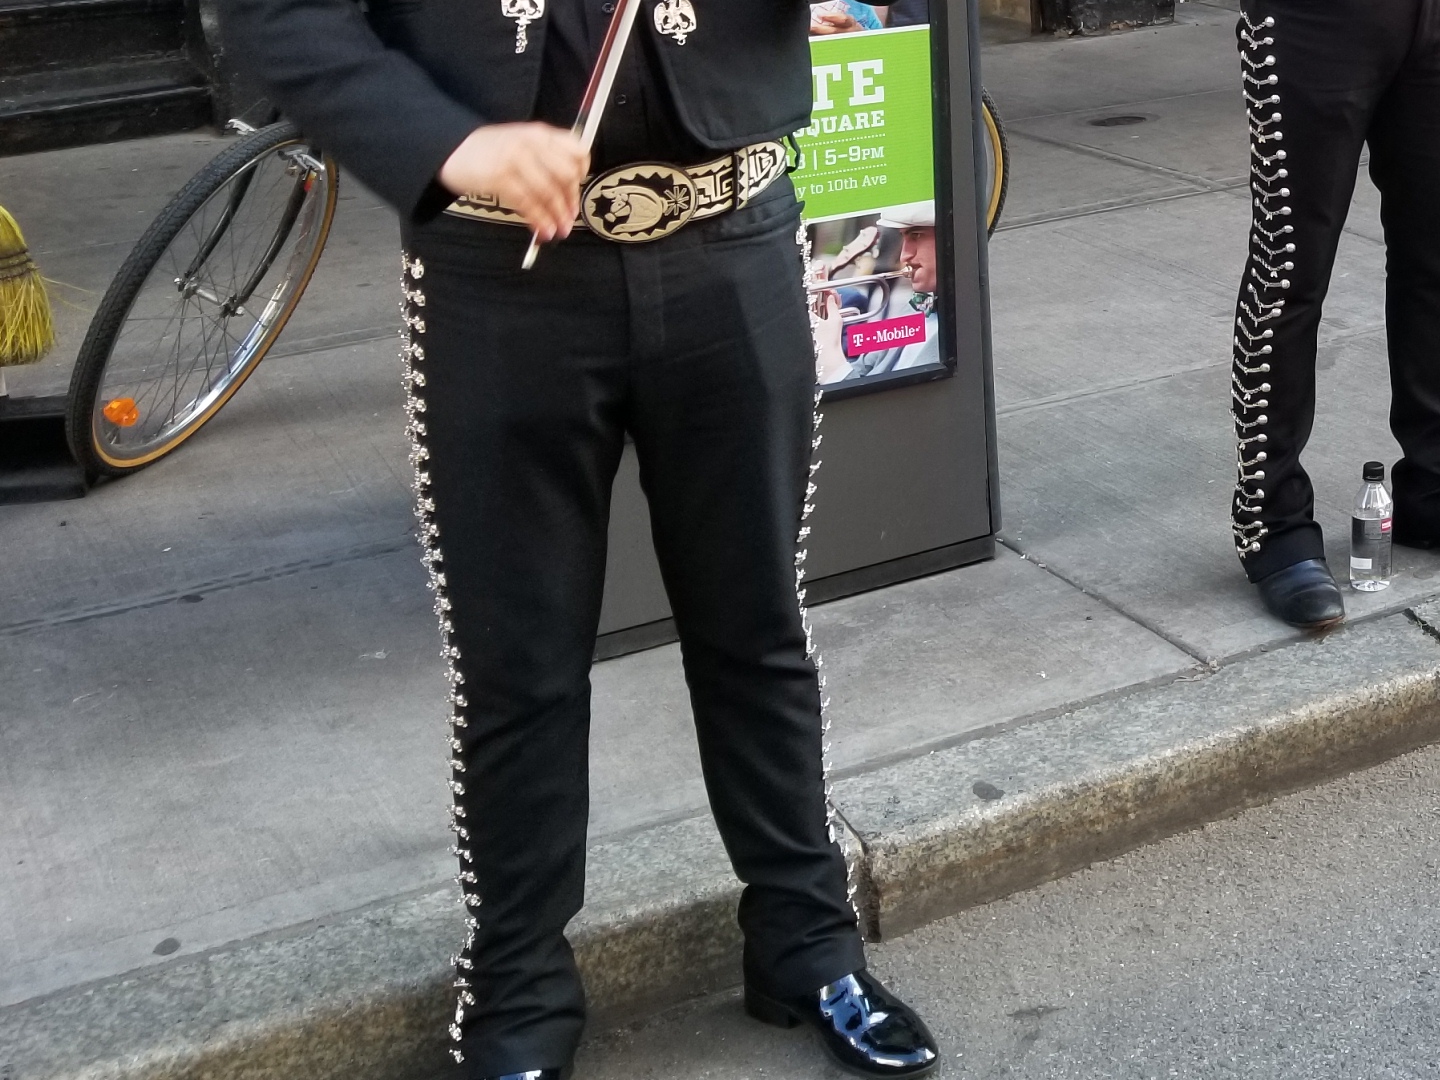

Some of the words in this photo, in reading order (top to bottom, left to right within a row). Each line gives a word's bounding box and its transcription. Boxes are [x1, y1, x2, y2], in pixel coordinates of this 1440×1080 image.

[810, 182, 824, 195] to
[827, 176, 858, 193] 10th
[862, 174, 887, 188] Ave
